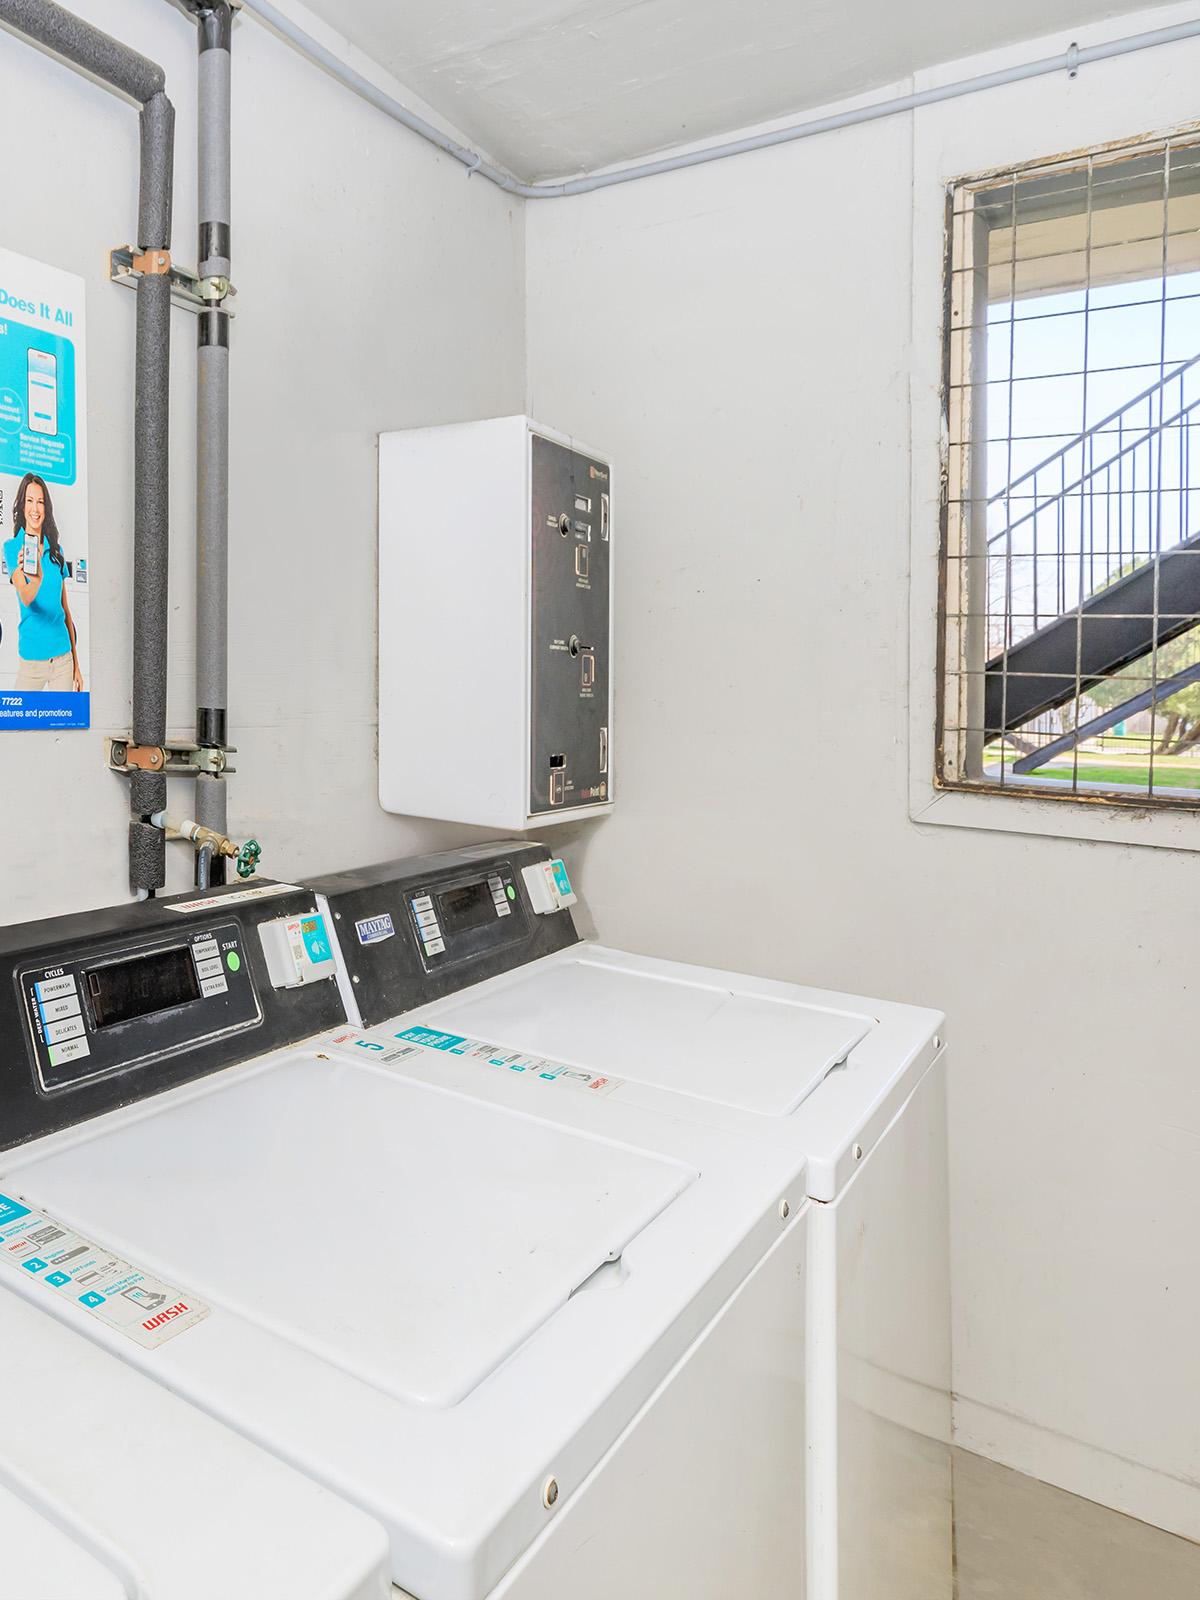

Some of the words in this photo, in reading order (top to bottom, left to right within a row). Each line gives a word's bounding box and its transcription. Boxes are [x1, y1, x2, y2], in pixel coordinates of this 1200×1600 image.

[40, 302, 51, 319] It
[55, 309, 73, 327] All
[1, 697, 23, 706] 77222
[25, 709, 38, 717] and
[38, 709, 73, 719] promotions
[358, 915, 392, 935] MAYTAG
[194, 932, 213, 942] OPTIONS
[221, 940, 238, 951] START
[44, 968, 64, 979] CYCLES
[55, 1005, 68, 1013] MIXED
[55, 1025, 77, 1036] DELICATES
[61, 1044, 79, 1054] NORMAL
[355, 1040, 384, 1051] 5
[30, 1261, 42, 1269] 2
[52, 1275, 64, 1283] 3
[88, 1295, 99, 1303] 4
[142, 1302, 189, 1331] WASH
